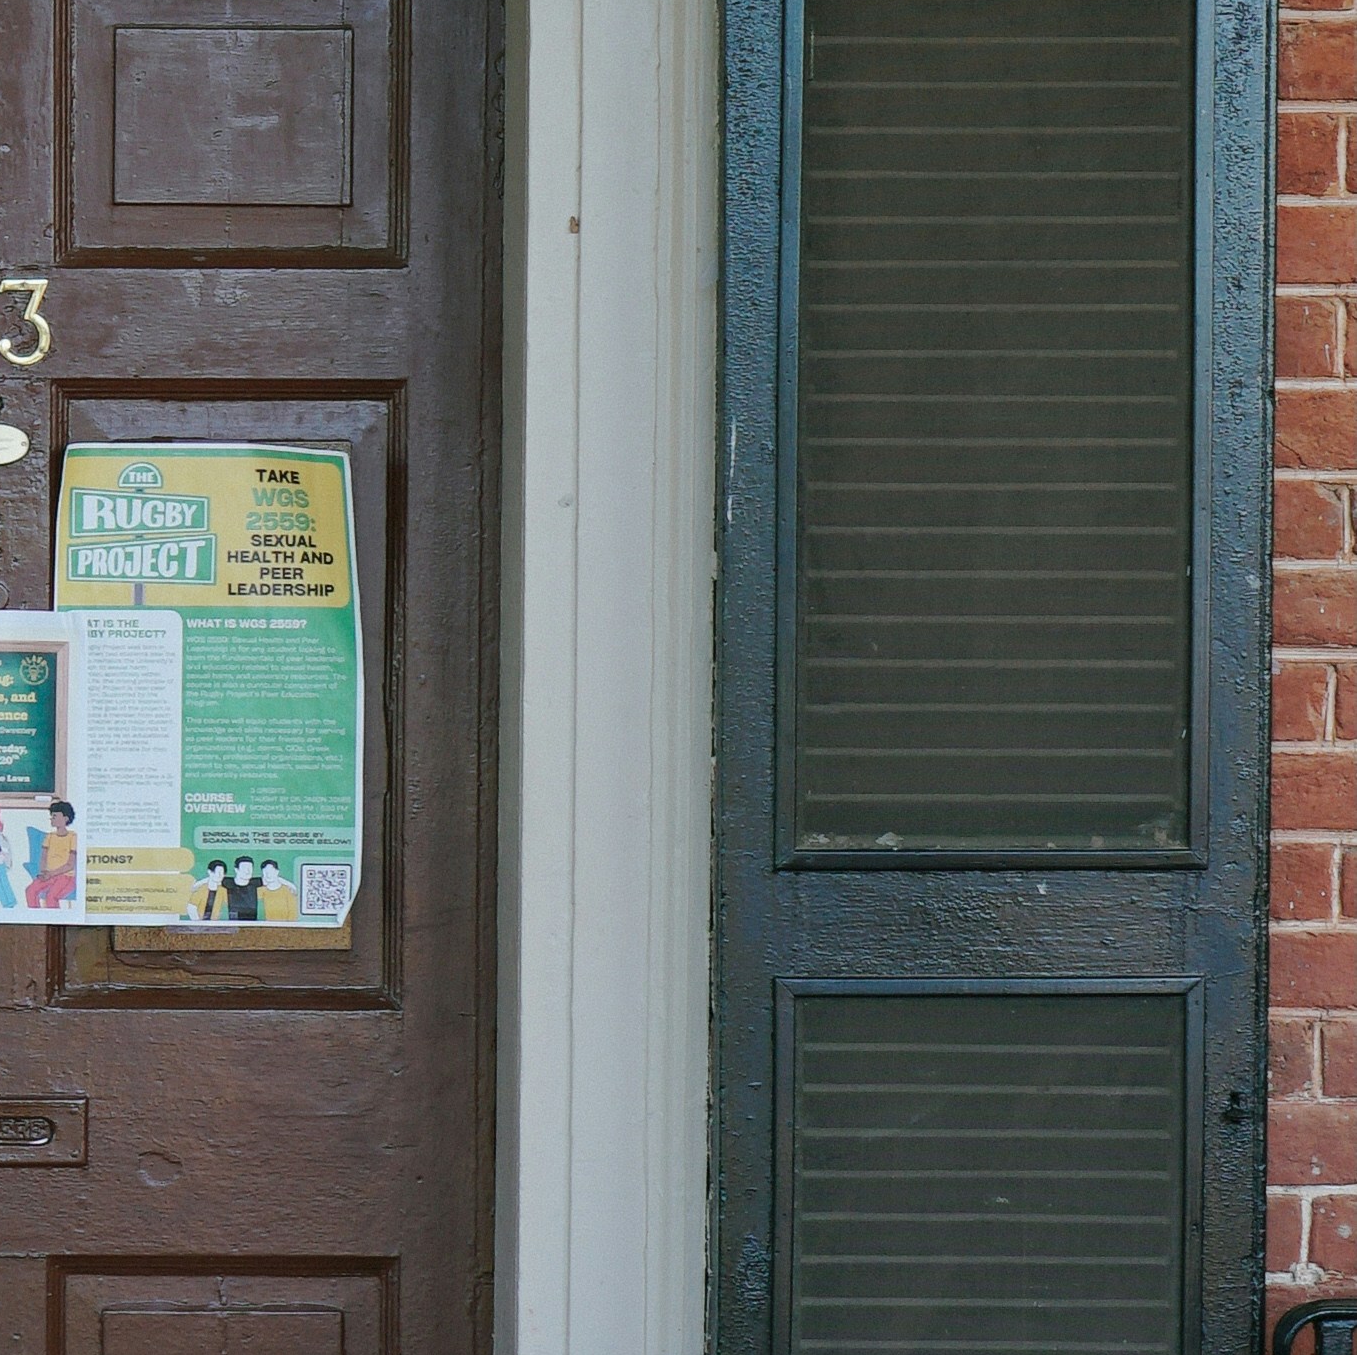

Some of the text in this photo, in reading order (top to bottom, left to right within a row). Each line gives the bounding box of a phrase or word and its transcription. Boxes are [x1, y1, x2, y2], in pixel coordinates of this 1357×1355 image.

[128, 470, 155, 483] THE
[255, 469, 300, 484] TAKE
[252, 487, 310, 508] WGS
[81, 495, 197, 530] RUGBY
[245, 512, 317, 532] 2559:
[251, 534, 316, 547] SEXUAL
[77, 539, 206, 578] PROJECT
[227, 551, 334, 565] HEALTH AND
[260, 567, 304, 580] PEER
[228, 583, 335, 597] LEADERSHIP
[103, 619, 114, 628] IS
[116, 619, 140, 628] THE
[186, 618, 222, 629] WHAT
[224, 618, 237, 629] IS
[239, 618, 267, 629] WGS
[108, 629, 166, 638] PROJECT?
[10, 692, 37, 703] and
[184, 793, 234, 803] COURSE
[184, 803, 246, 814] OVERVIEW
